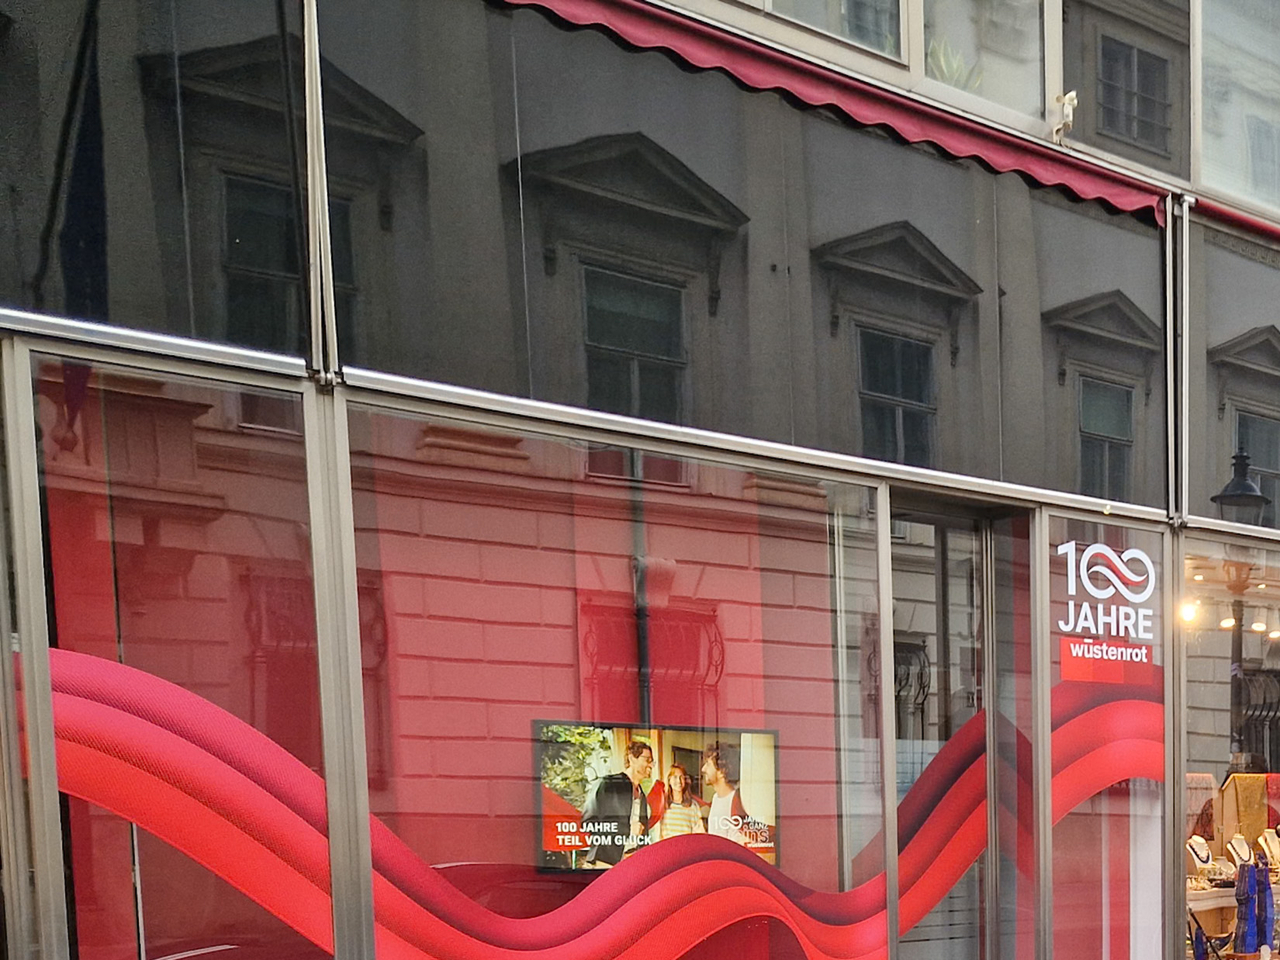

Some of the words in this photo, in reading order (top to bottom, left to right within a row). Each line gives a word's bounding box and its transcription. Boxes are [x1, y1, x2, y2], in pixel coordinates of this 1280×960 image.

[1057, 600, 1154, 639] JAHRE
[1070, 638, 1148, 663] wüstenrot
[555, 822, 577, 833] 100
[579, 822, 618, 833] JAHRE
[556, 835, 583, 846] TEIL
[584, 835, 612, 846] VOM
